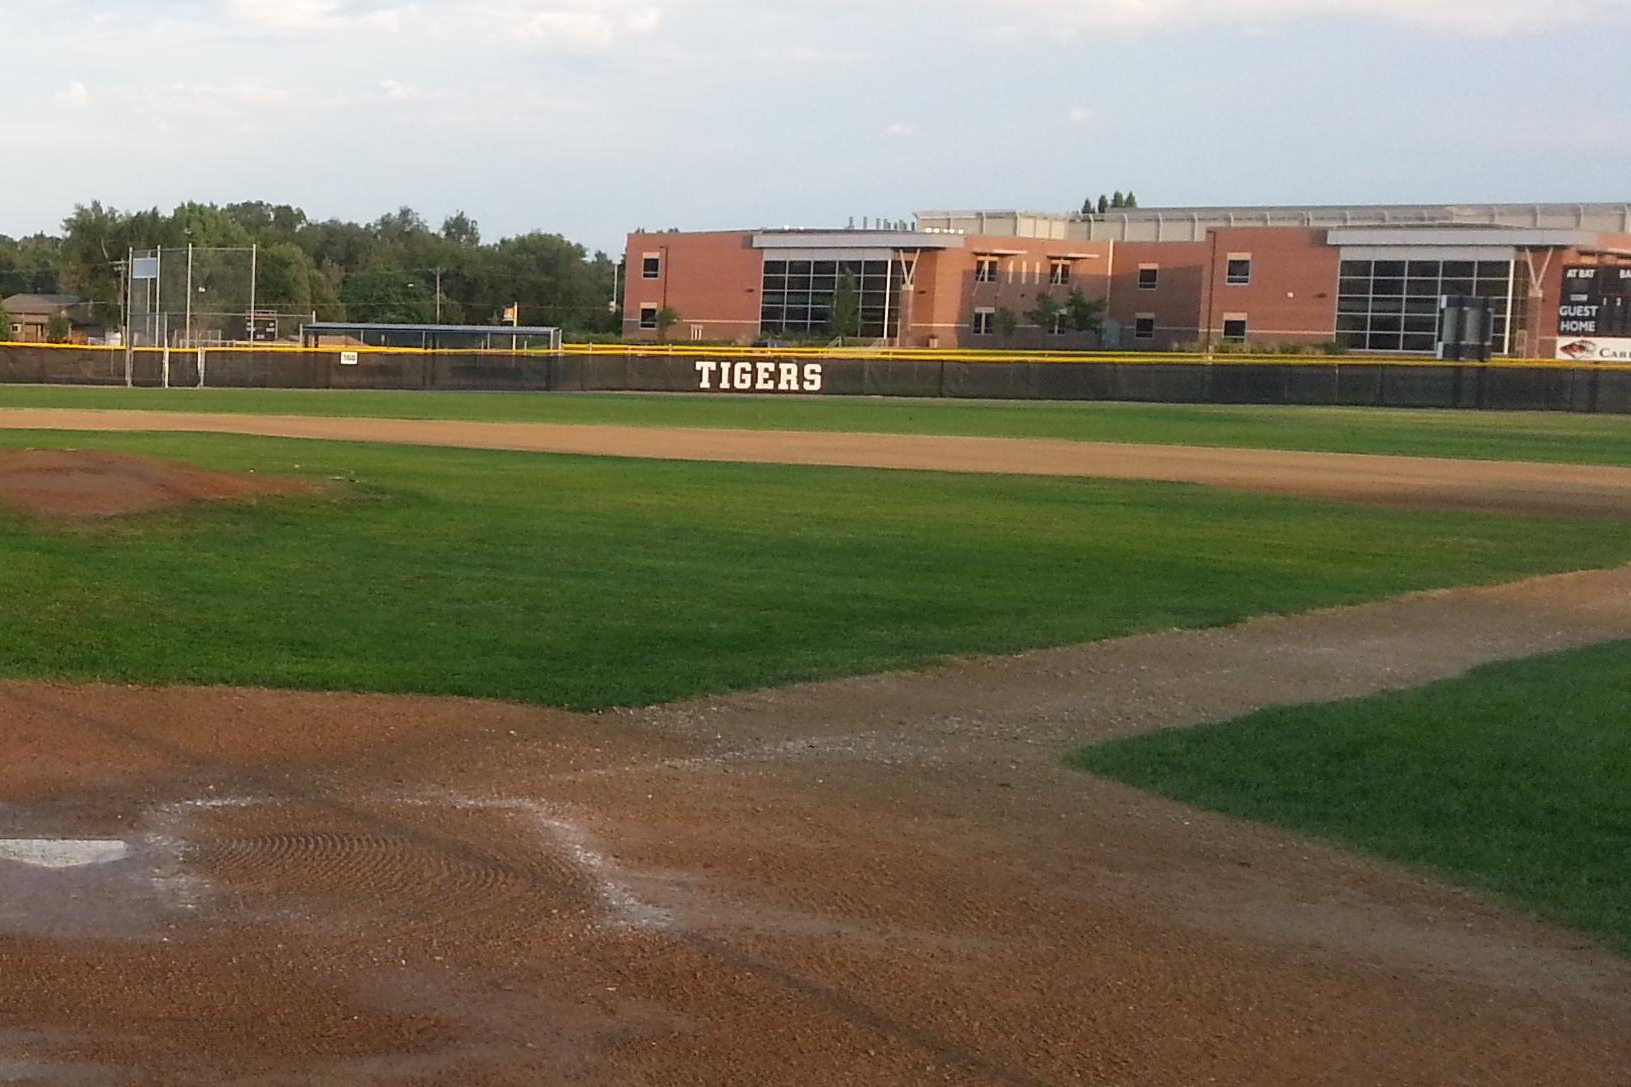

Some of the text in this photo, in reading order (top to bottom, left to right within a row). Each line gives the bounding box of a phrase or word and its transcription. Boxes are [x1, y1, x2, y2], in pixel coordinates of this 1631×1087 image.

[1567, 268, 1595, 278] AT BAT
[1559, 305, 1599, 317] GUEST
[1560, 320, 1596, 332] HOME
[695, 361, 822, 391] TIGERS
